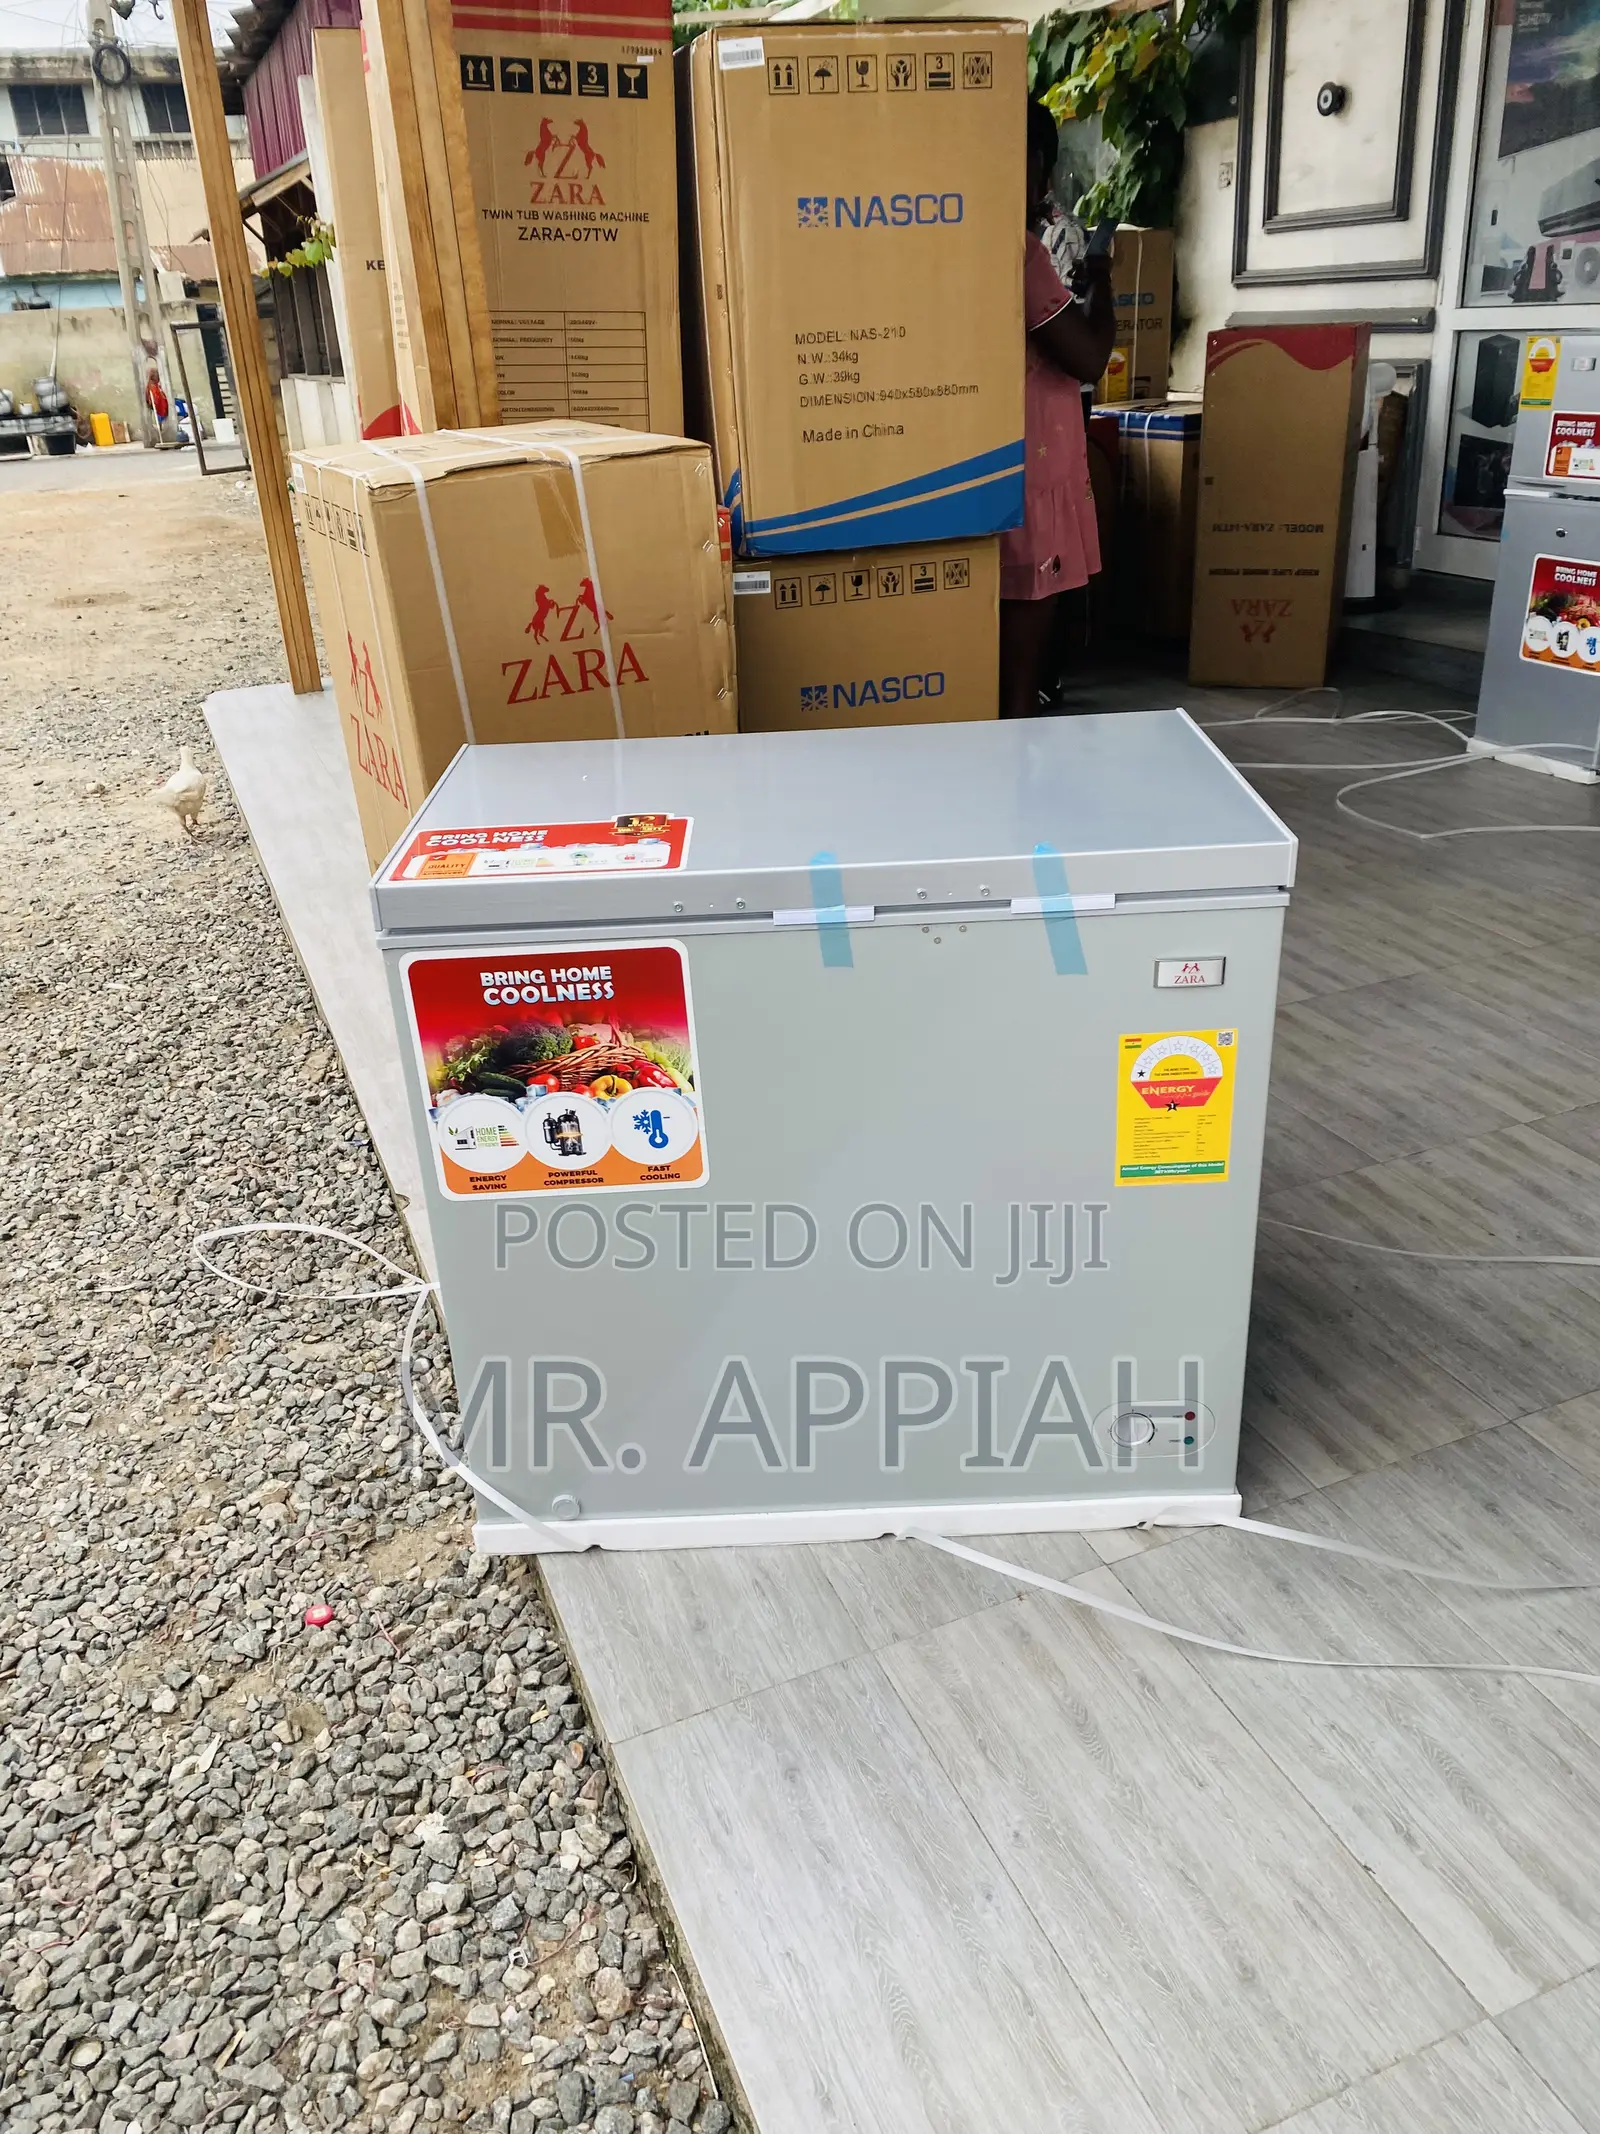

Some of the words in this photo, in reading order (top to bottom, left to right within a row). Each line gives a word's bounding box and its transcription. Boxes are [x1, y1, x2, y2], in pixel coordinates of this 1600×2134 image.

[530, 182, 606, 205] ZARA
[482, 209, 513, 220] TWIN
[516, 210, 539, 220] TUB
[543, 211, 596, 221] WASHING
[600, 212, 650, 222] MACHINE
[834, 193, 963, 228] NASCO
[518, 227, 618, 242] ZARA-07TW
[850, 326, 906, 341] NAS-210
[803, 428, 842, 444] Made
[846, 427, 859, 440] in
[863, 423, 905, 438] China
[1554, 573, 1596, 587] COOLNESS
[1231, 599, 1292, 617] ZARA
[501, 642, 650, 705] ZARA
[832, 671, 945, 709] NASCO
[350, 713, 408, 810] ZARA
[425, 835, 546, 847] COOLNESS
[430, 832, 488, 841] BRING
[493, 829, 549, 838] HOME
[480, 969, 546, 987] BRING
[550, 966, 612, 983] HOME
[1174, 974, 1206, 985] ZARA
[483, 981, 615, 1006] COOLNESS
[1142, 1085, 1196, 1096] ENERGY
[475, 1127, 498, 1136] HOME
[548, 1169, 598, 1179] POWERFUL
[647, 1165, 672, 1173] FAST
[469, 1174, 508, 1183] ENERGY
[543, 1177, 604, 1187] COMPRESSOR
[640, 1172, 682, 1182] COOLING
[472, 1183, 508, 1191] SAVING
